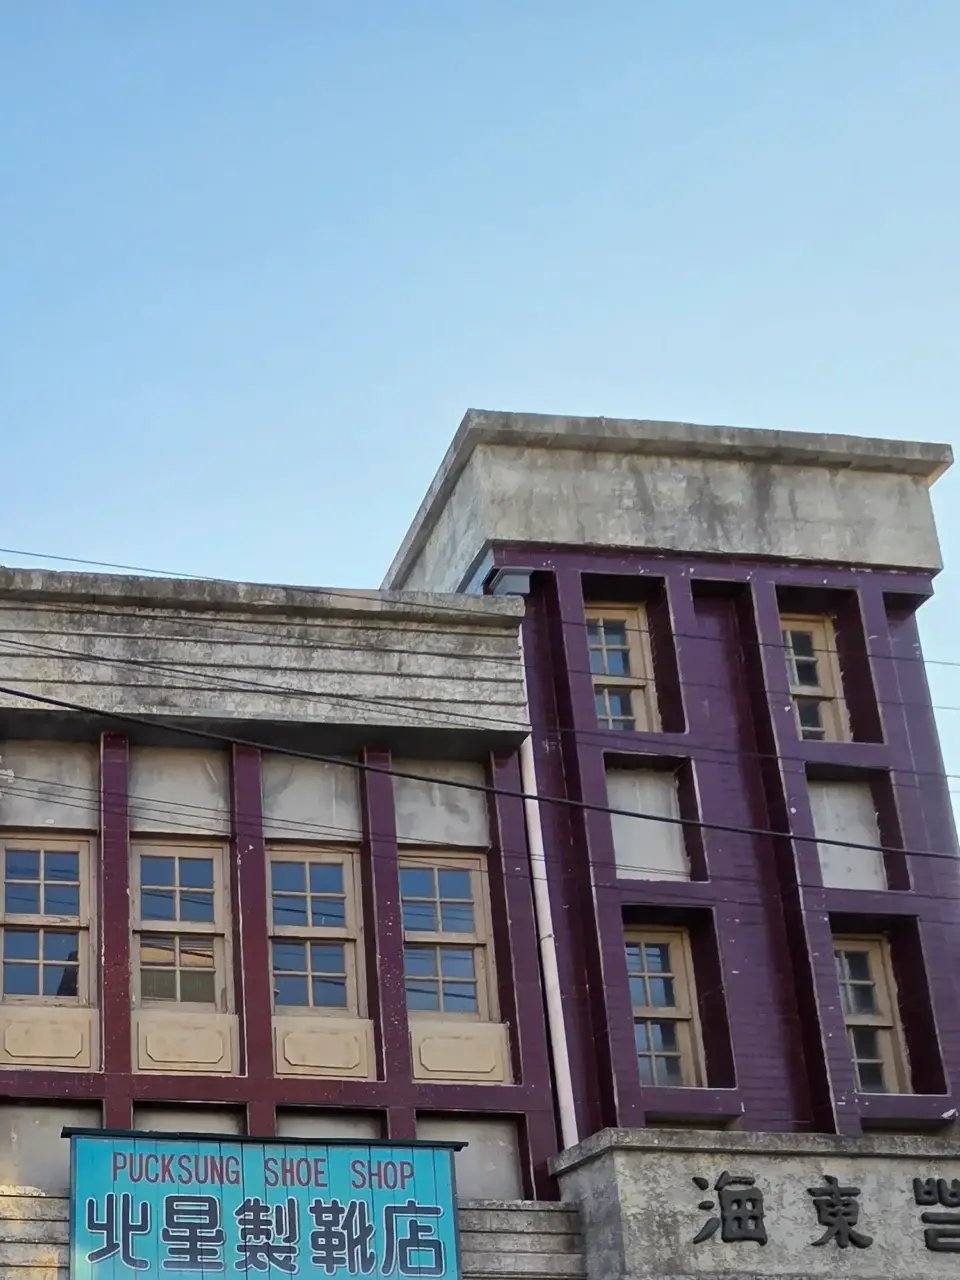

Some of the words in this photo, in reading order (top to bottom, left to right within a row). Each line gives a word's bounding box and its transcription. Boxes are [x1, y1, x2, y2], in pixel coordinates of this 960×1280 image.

[112, 1151, 240, 1186] PUCKSUNG
[264, 1157, 327, 1188] SHOE
[351, 1159, 415, 1190] SHOP
[86, 1192, 446, 1277] 北星製靴店
